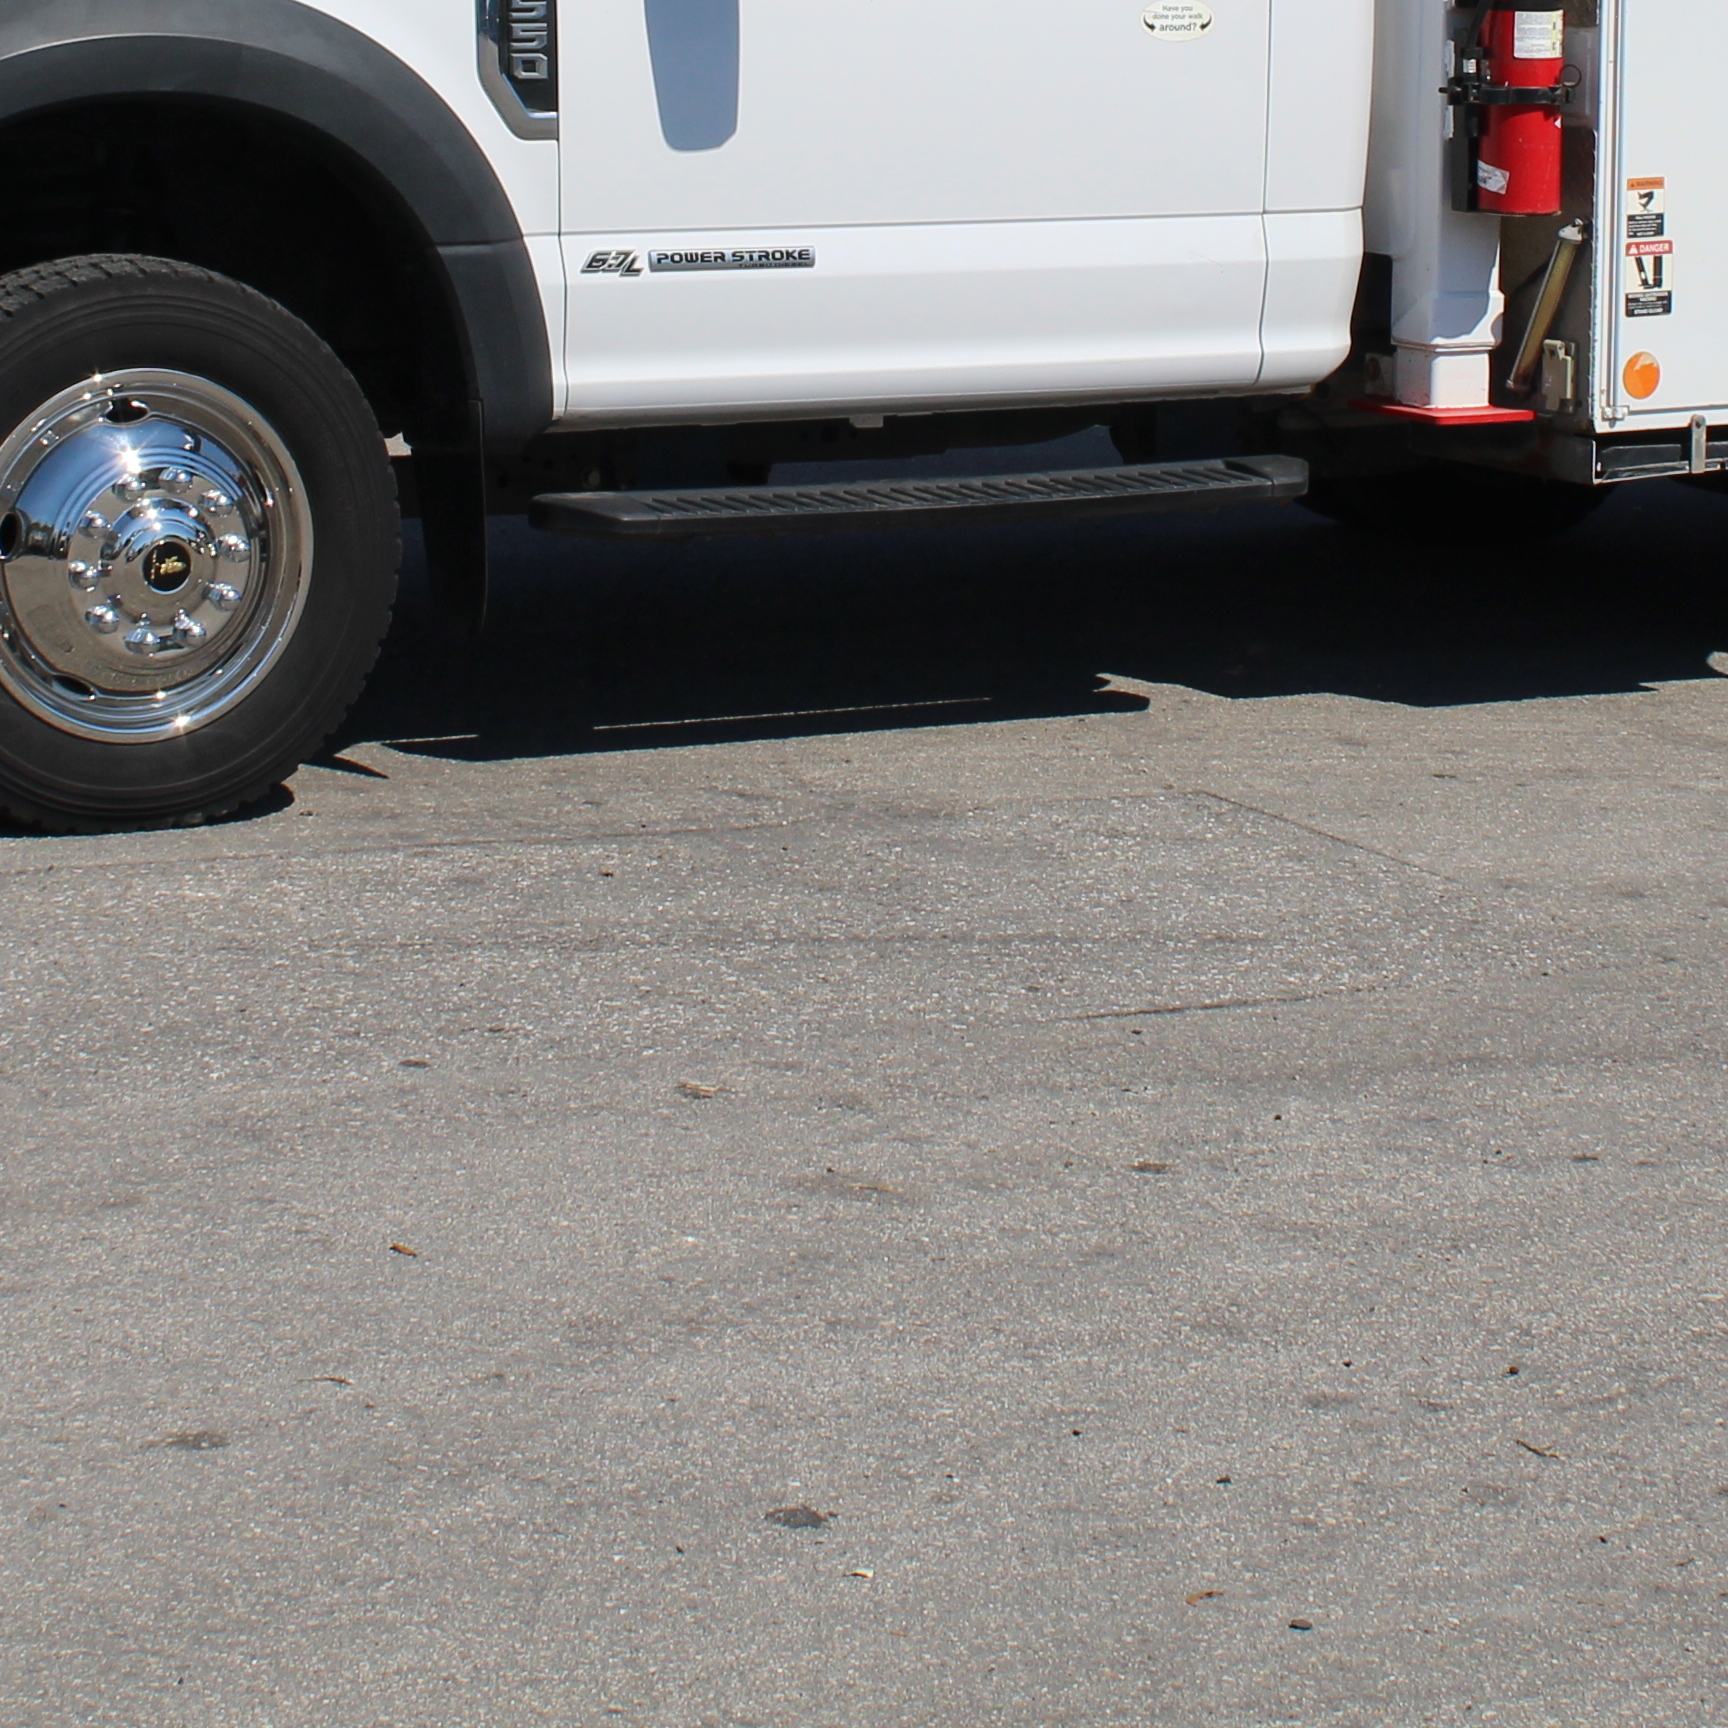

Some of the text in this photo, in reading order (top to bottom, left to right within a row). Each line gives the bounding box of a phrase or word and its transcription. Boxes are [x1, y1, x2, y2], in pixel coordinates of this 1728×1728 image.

[1159, 22, 1197, 32] around?
[1639, 243, 1670, 253] DANGER
[657, 249, 811, 264] POWER STROKE
